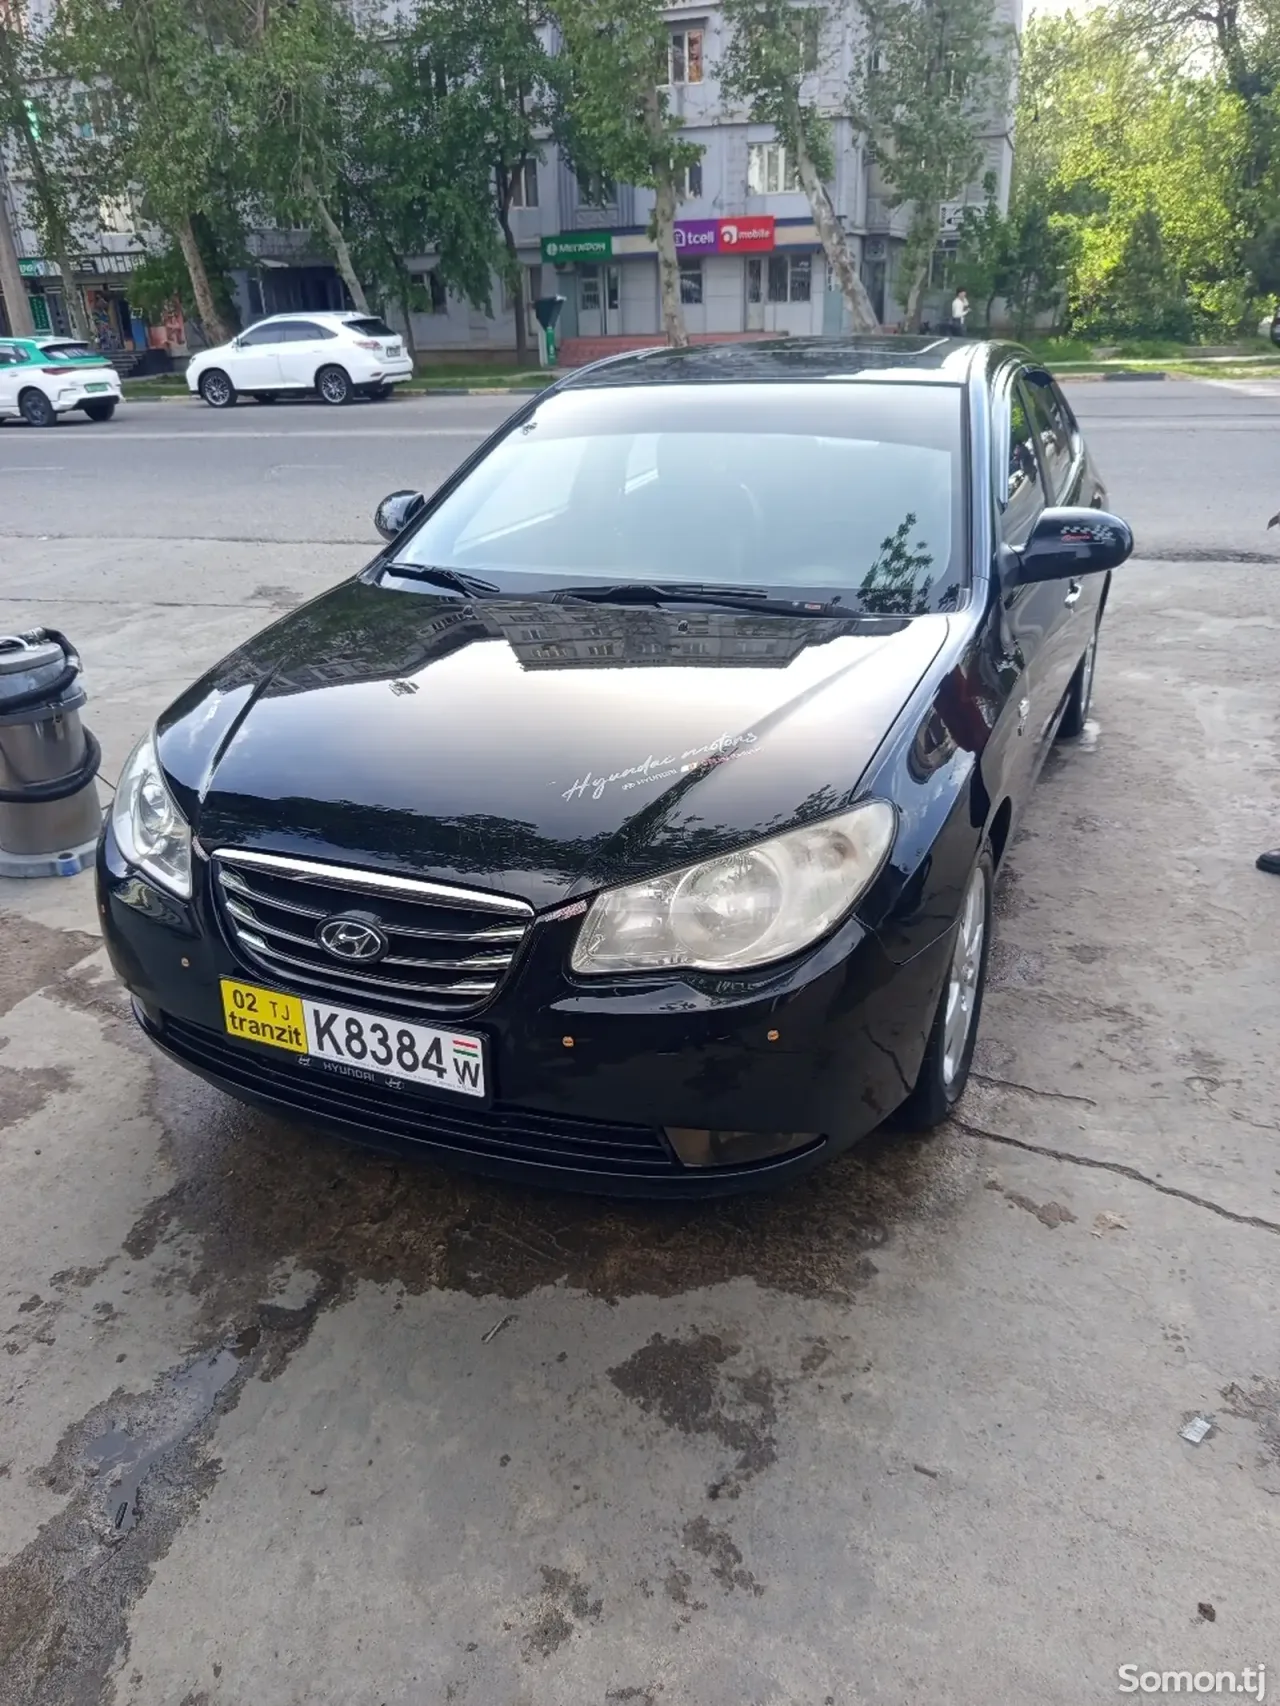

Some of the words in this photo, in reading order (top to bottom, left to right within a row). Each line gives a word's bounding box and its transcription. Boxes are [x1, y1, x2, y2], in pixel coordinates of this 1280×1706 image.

[687, 231, 715, 245] tcell
[738, 229, 770, 240] mobile
[232, 989, 258, 1013] 02
[268, 1000, 291, 1021] TJ
[228, 1011, 302, 1047] tranzit
[313, 1009, 448, 1079] K8384
[453, 1057, 480, 1088] W
[323, 1062, 376, 1083] HYUNDAI
